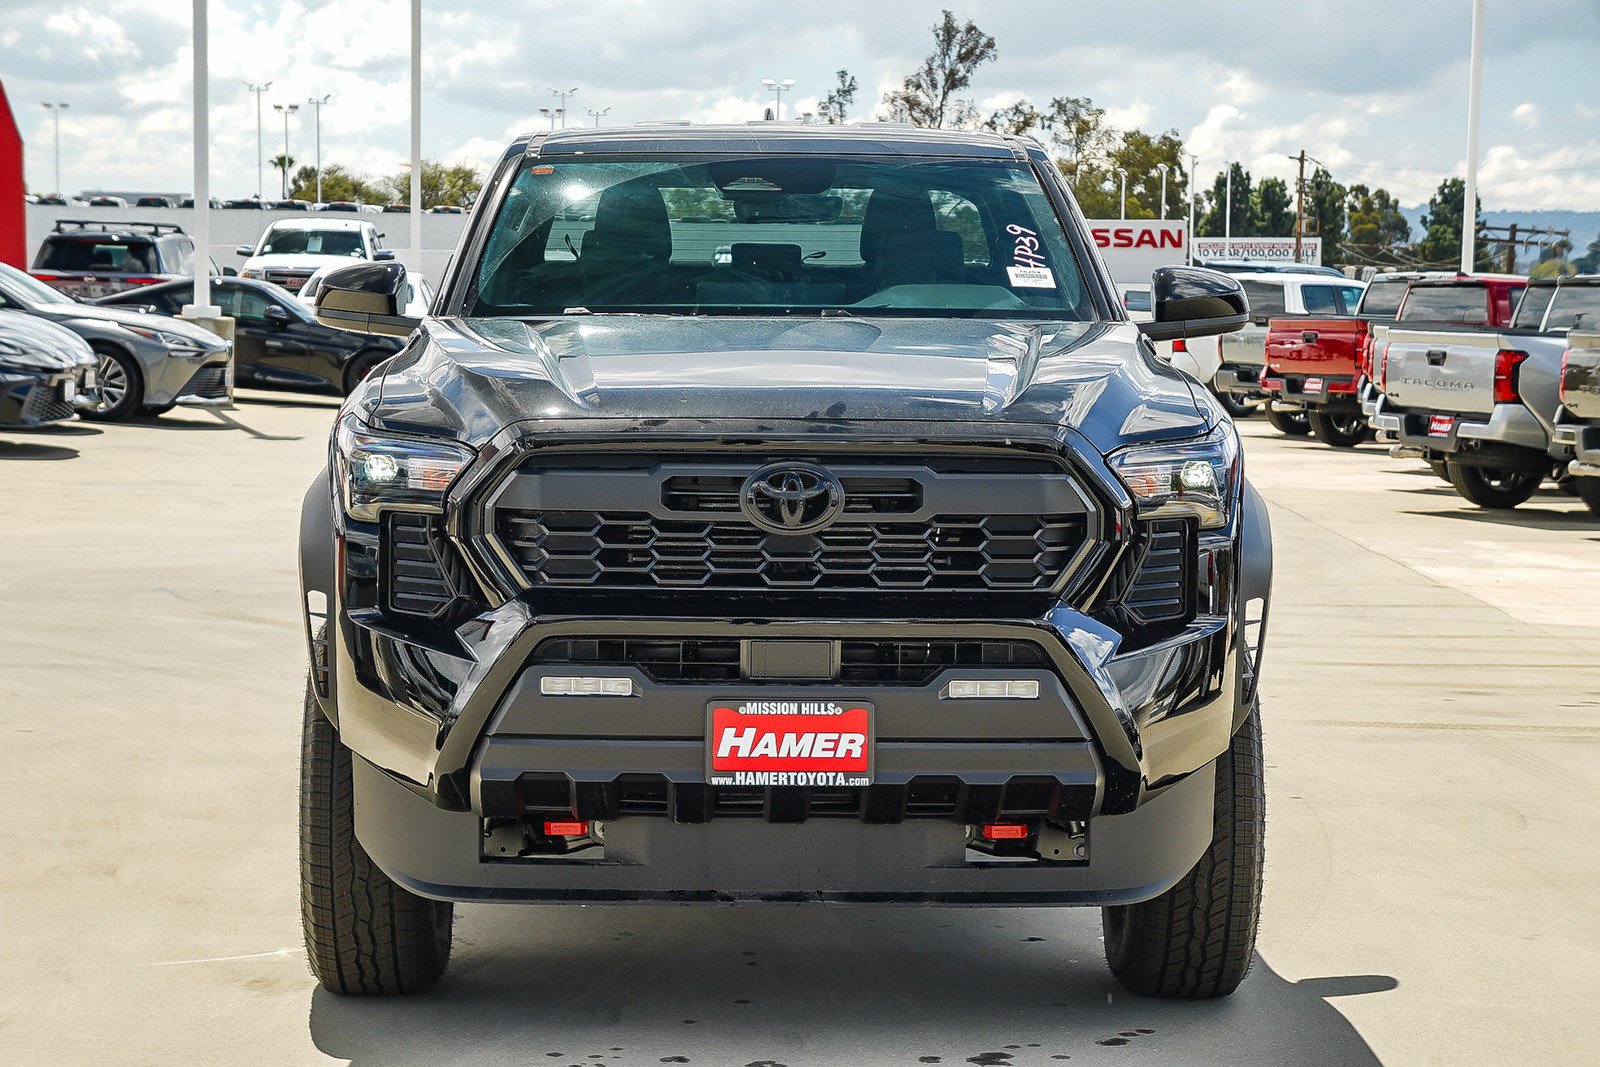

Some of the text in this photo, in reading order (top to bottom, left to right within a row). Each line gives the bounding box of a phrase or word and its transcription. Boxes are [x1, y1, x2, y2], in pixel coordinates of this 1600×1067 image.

[1091, 228, 1183, 248] SSAN
[1198, 248, 1210, 257] 10
[1401, 377, 1474, 390] TACOMA
[746, 702, 835, 715] MISSION HILLS
[716, 727, 866, 758] HAMER
[711, 772, 869, 786] www.HAMERTOYOTA.com
